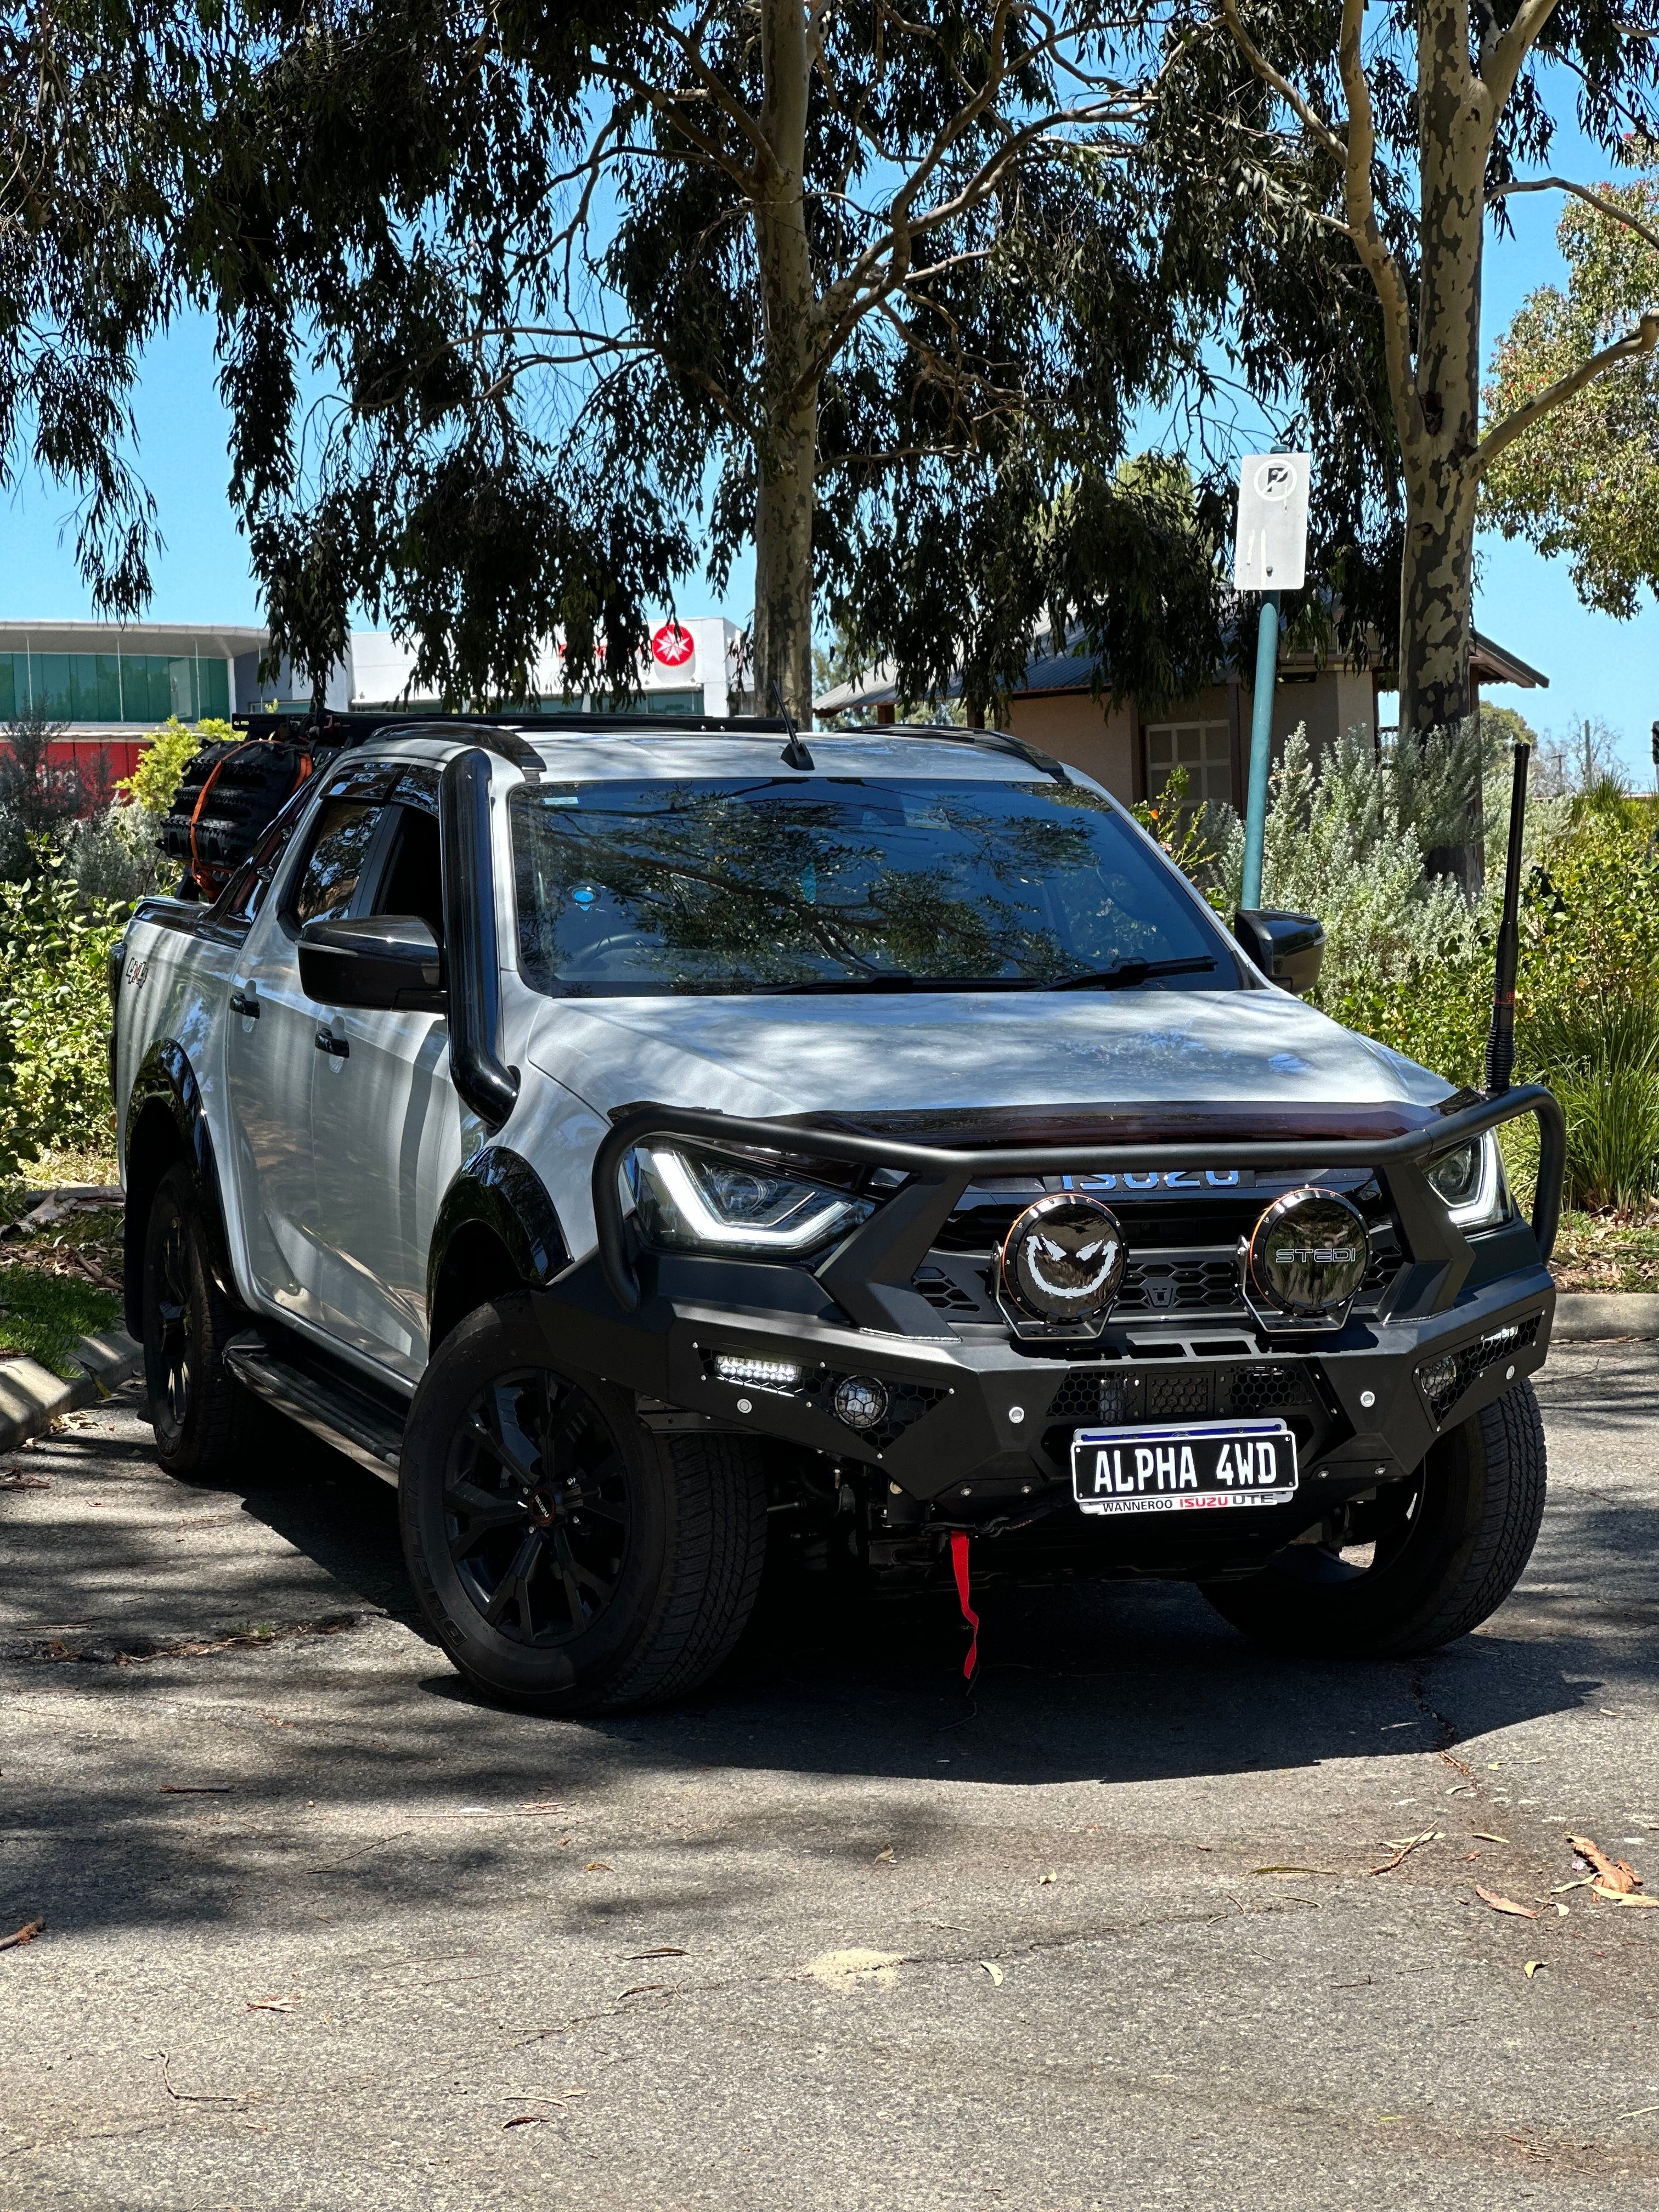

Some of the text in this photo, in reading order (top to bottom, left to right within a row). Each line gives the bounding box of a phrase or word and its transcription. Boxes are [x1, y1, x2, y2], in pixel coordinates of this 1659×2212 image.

[1276, 1248, 1356, 1263] STEDI
[1094, 1441, 1277, 1493] ALPHA 4WD
[1103, 1494, 1274, 1513] WANNEROO ISUZU UTE
